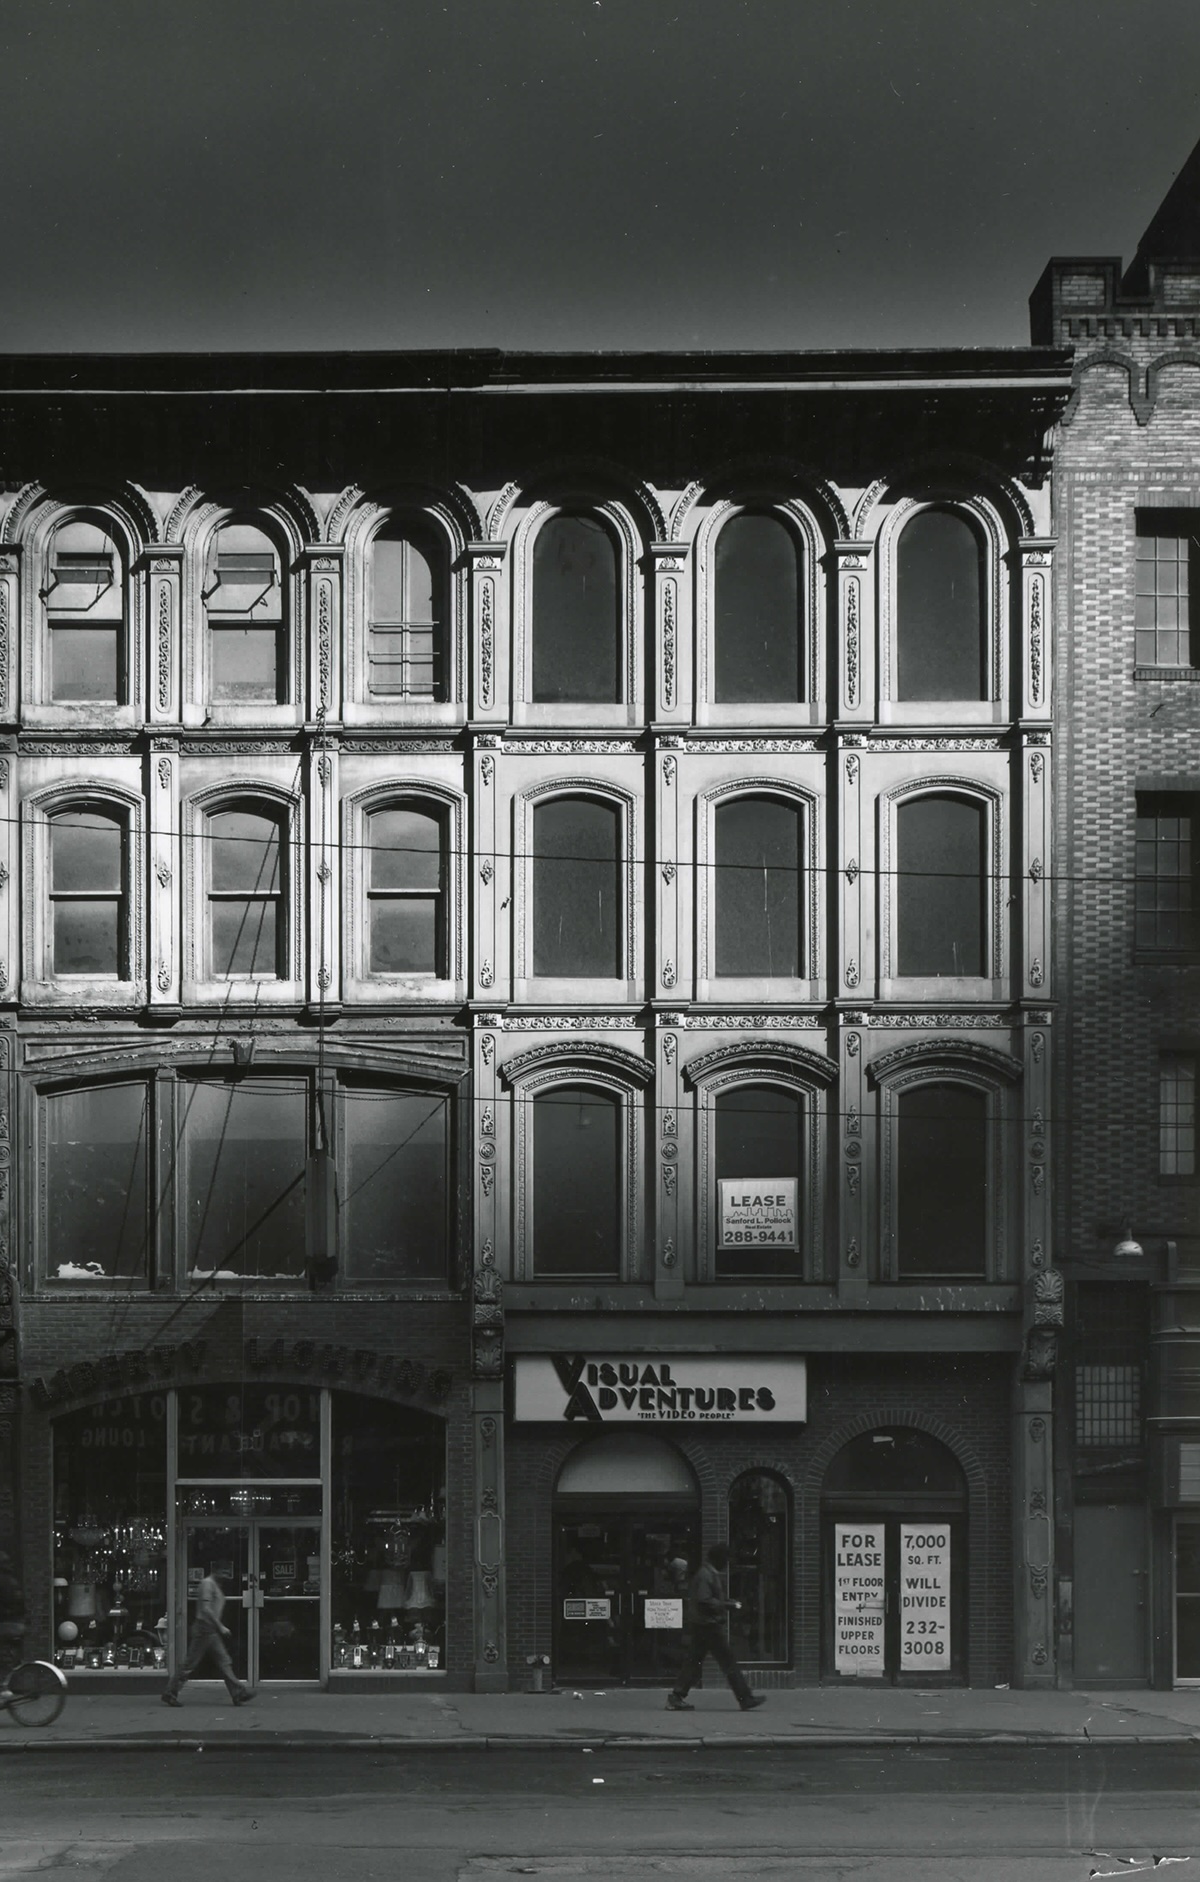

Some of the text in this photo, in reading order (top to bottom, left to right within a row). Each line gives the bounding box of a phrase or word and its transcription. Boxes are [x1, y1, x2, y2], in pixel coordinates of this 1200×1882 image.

[731, 1195, 786, 1207] LEASE
[724, 1231, 793, 1243] 288-9441
[31, 1338, 453, 1404] LIBERTY LIGHTING
[551, 1356, 676, 1396] VISUAL
[563, 1380, 776, 1421] ADVENTURES
[659, 1410, 695, 1419] VIDEO
[842, 1535, 876, 1548] FOR
[904, 1535, 946, 1550] 7,000
[837, 1553, 881, 1566] LEASE
[908, 1555, 941, 1565] SQ. FT.
[274, 1564, 294, 1575] SALE
[852, 1578, 883, 1587] FLOOR
[906, 1578, 941, 1589] WILL
[903, 1596, 946, 1608] DIVIDE
[838, 1616, 882, 1626] FINISHED
[906, 1621, 945, 1634] 232-
[841, 1631, 874, 1640] UPPER
[838, 1645, 880, 1655] FLOORS
[904, 1641, 944, 1655] 3008
